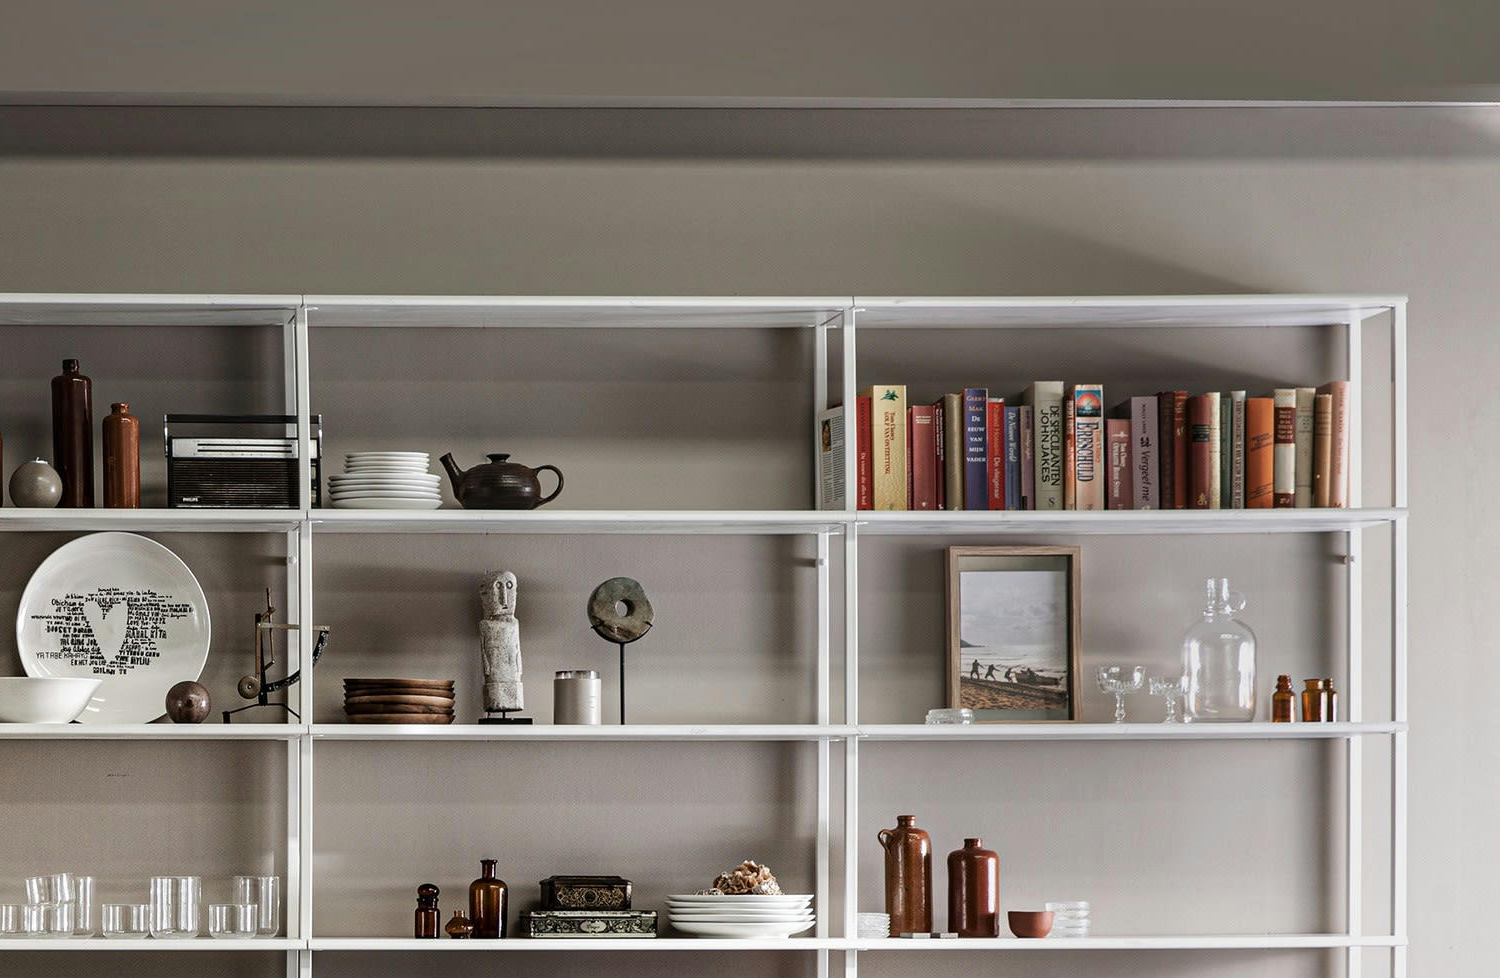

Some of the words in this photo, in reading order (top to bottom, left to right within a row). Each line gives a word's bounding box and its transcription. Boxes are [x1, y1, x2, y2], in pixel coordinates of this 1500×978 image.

[1040, 409, 1050, 442] JOHN
[1050, 405, 1060, 418] DE
[1041, 444, 1050, 483] JAKES
[1050, 420, 1061, 486] SPECULANTEN
[1076, 421, 1099, 482] ERESCHULD
[1139, 450, 1151, 485] Vergeef
[1141, 486, 1150, 502] me
